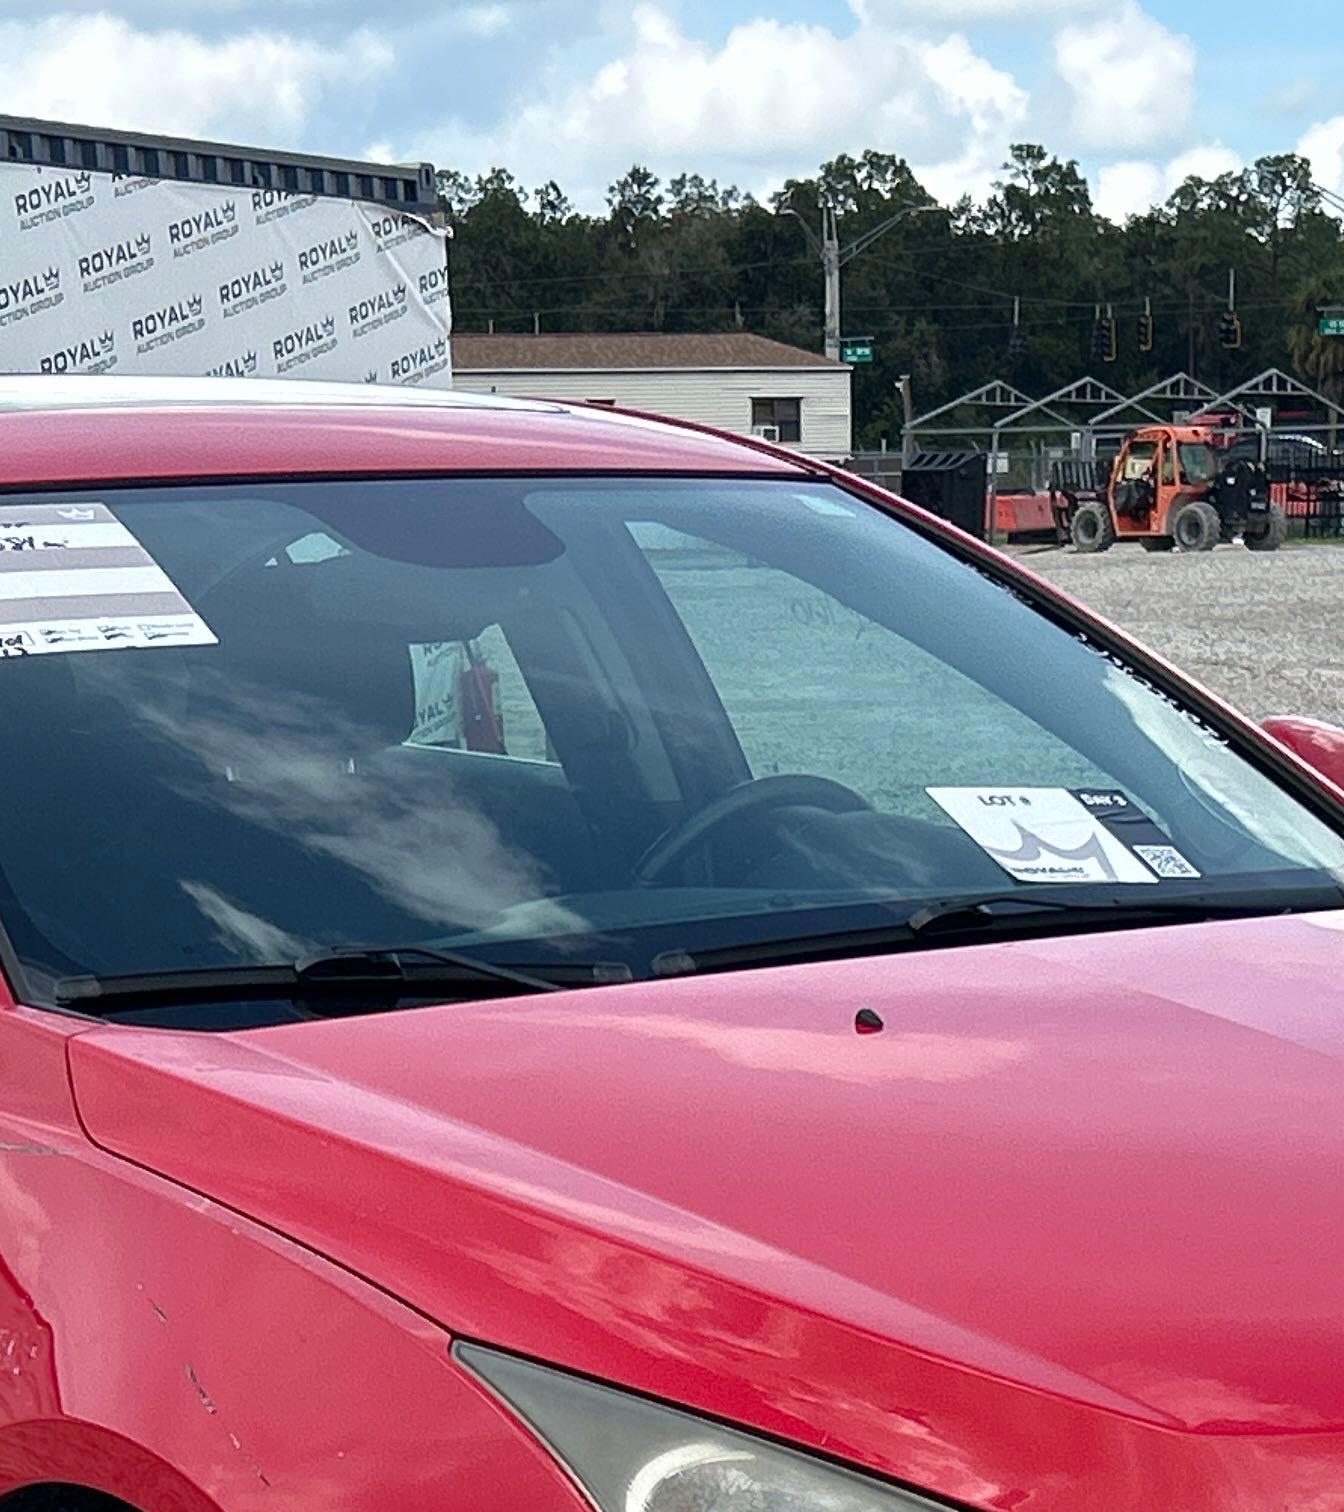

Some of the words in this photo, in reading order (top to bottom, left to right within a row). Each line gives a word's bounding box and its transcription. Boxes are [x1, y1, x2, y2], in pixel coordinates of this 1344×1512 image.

[14, 178, 77, 216] ROYAL
[168, 208, 224, 244] ROYAL
[78, 240, 138, 280] ROYAL
[298, 236, 348, 272] ROYAL
[219, 268, 272, 305] ROYAL
[132, 300, 190, 341] ROYAL
[349, 291, 394, 326] ROYAL
[41, 338, 102, 374] ROYAL
[272, 324, 324, 360] ROYAL
[392, 344, 435, 380] ROYAL
